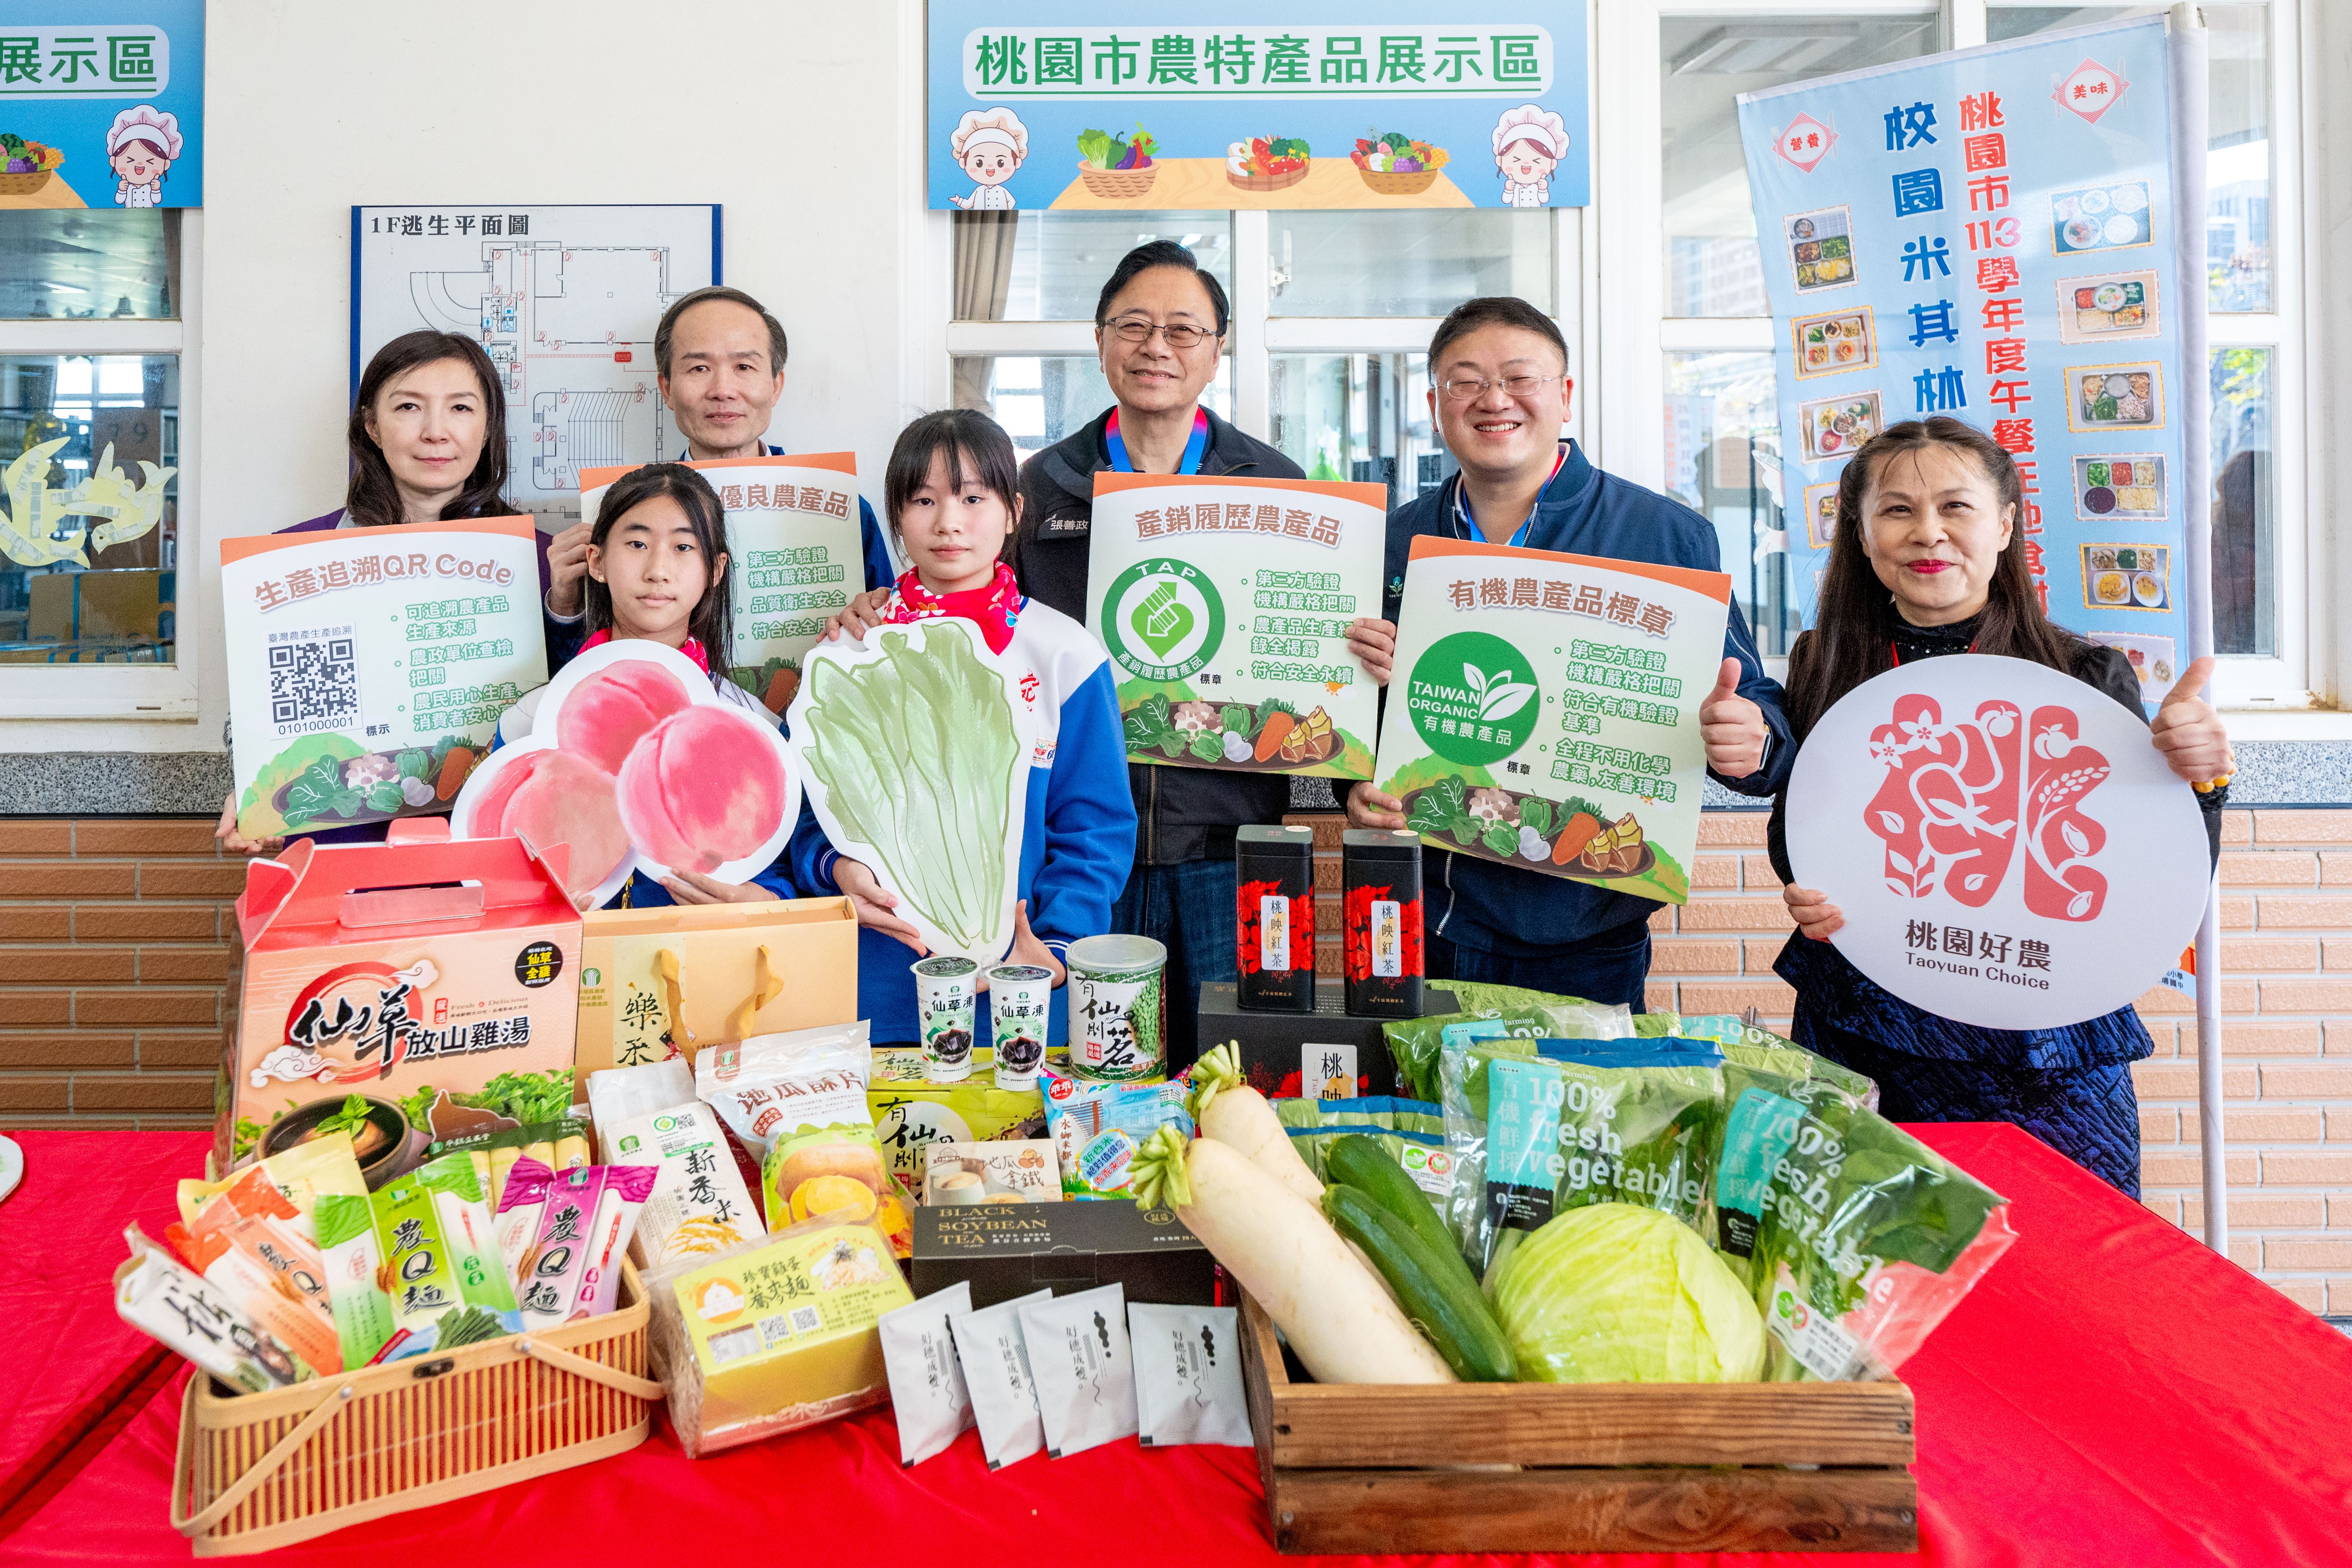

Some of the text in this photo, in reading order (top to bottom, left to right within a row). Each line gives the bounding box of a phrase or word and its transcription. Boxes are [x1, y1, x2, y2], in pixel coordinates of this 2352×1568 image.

[0, 36, 157, 84] 展示區
[975, 33, 1542, 87] 桃園市農特產品展示區
[2073, 81, 2109, 101] 美味
[1790, 131, 1821, 153] 營養
[372, 214, 530, 236] 1F逃生平面圖
[1883, 101, 1967, 413] 校園米其林
[1050, 518, 1088, 531] 張善政
[1134, 502, 1342, 547] 產銷履歷農產品
[747, 547, 828, 568] 第三方驗證
[1135, 561, 1197, 579] TAP
[255, 553, 513, 611] 生產追溯QR Code
[749, 565, 844, 589] 機構嚴格把關
[1256, 569, 1341, 592] 第三方驗證
[406, 595, 509, 621] 可追溯農產品
[750, 590, 847, 614] 品質衛生安全
[1254, 591, 1356, 614] 機構嚴格把關
[1448, 577, 1674, 637] 有機農產品標章
[267, 625, 353, 643] 臺灣農產生產追溯
[406, 619, 477, 642] 生產來源
[410, 640, 513, 667] 農政單位查檢
[1251, 638, 1319, 659] 錄全揭露
[1570, 640, 1666, 673] 第三方驗證
[409, 667, 445, 687] 把關
[1116, 650, 1204, 680] 產銷履歷農產品
[1252, 661, 1354, 685] 符合安全永續
[1200, 672, 1222, 686] 標章
[1567, 661, 1681, 699] 機構嚴格把關
[1413, 681, 1481, 706] TAIWAN
[1409, 697, 1479, 720] ORGANIC
[1563, 689, 1678, 727] 符合有機驗證
[278, 716, 354, 735] 0101000001
[366, 723, 390, 736] 標示
[1423, 715, 1512, 746] 有機農產品
[1562, 712, 1601, 736] 基準
[1506, 760, 1531, 776] 標章
[1555, 738, 1671, 776] 全程不用化學
[1270, 900, 1283, 968] 桃映紅茶
[1381, 904, 1394, 974] 桃映紅茶
[1904, 918, 2052, 972] 桃園好農
[527, 951, 553, 966] 仙草
[1906, 952, 2050, 990] Taoyuan Choice
[526, 965, 551, 980] 全雞
[488, 997, 528, 1006] Delicious
[932, 995, 973, 1012] 仙草凍
[1000, 1003, 1044, 1019] 仙草凍
[290, 983, 421, 1066] 仙草
[1504, 1017, 1535, 1026] farming
[404, 1015, 532, 1057] 放山雞湯
[1050, 1081, 1073, 1093] 乖乖
[1562, 1070, 1597, 1082] farming
[736, 1070, 866, 1115] 地瓜酥片
[1528, 1077, 1616, 1120] 100%
[876, 1096, 937, 1171] 有仙則
[1060, 1118, 1072, 1161] 水鄉米都
[1529, 1109, 1623, 1156] fresh
[1761, 1111, 1847, 1179] 100%
[982, 1155, 1022, 1170] 地瓜
[1083, 1136, 1114, 1164] 新香米
[1087, 1139, 1126, 1177] 絕對值得您
[1094, 1149, 1133, 1185] 乖乖來品味
[1528, 1149, 1701, 1206] vegetable
[685, 1149, 741, 1224] 新香米
[1002, 1170, 1045, 1190] 拿鐵
[939, 1207, 1016, 1217] BLACK
[938, 1219, 1047, 1232] SOYBEAN
[938, 1234, 986, 1245] TEA
[390, 1217, 456, 1316] 農Q麵
[520, 1204, 583, 1315] 農Q麵
[743, 1255, 801, 1284] 珍寶雞蛋
[749, 1274, 815, 1309] 蕎麥麵
